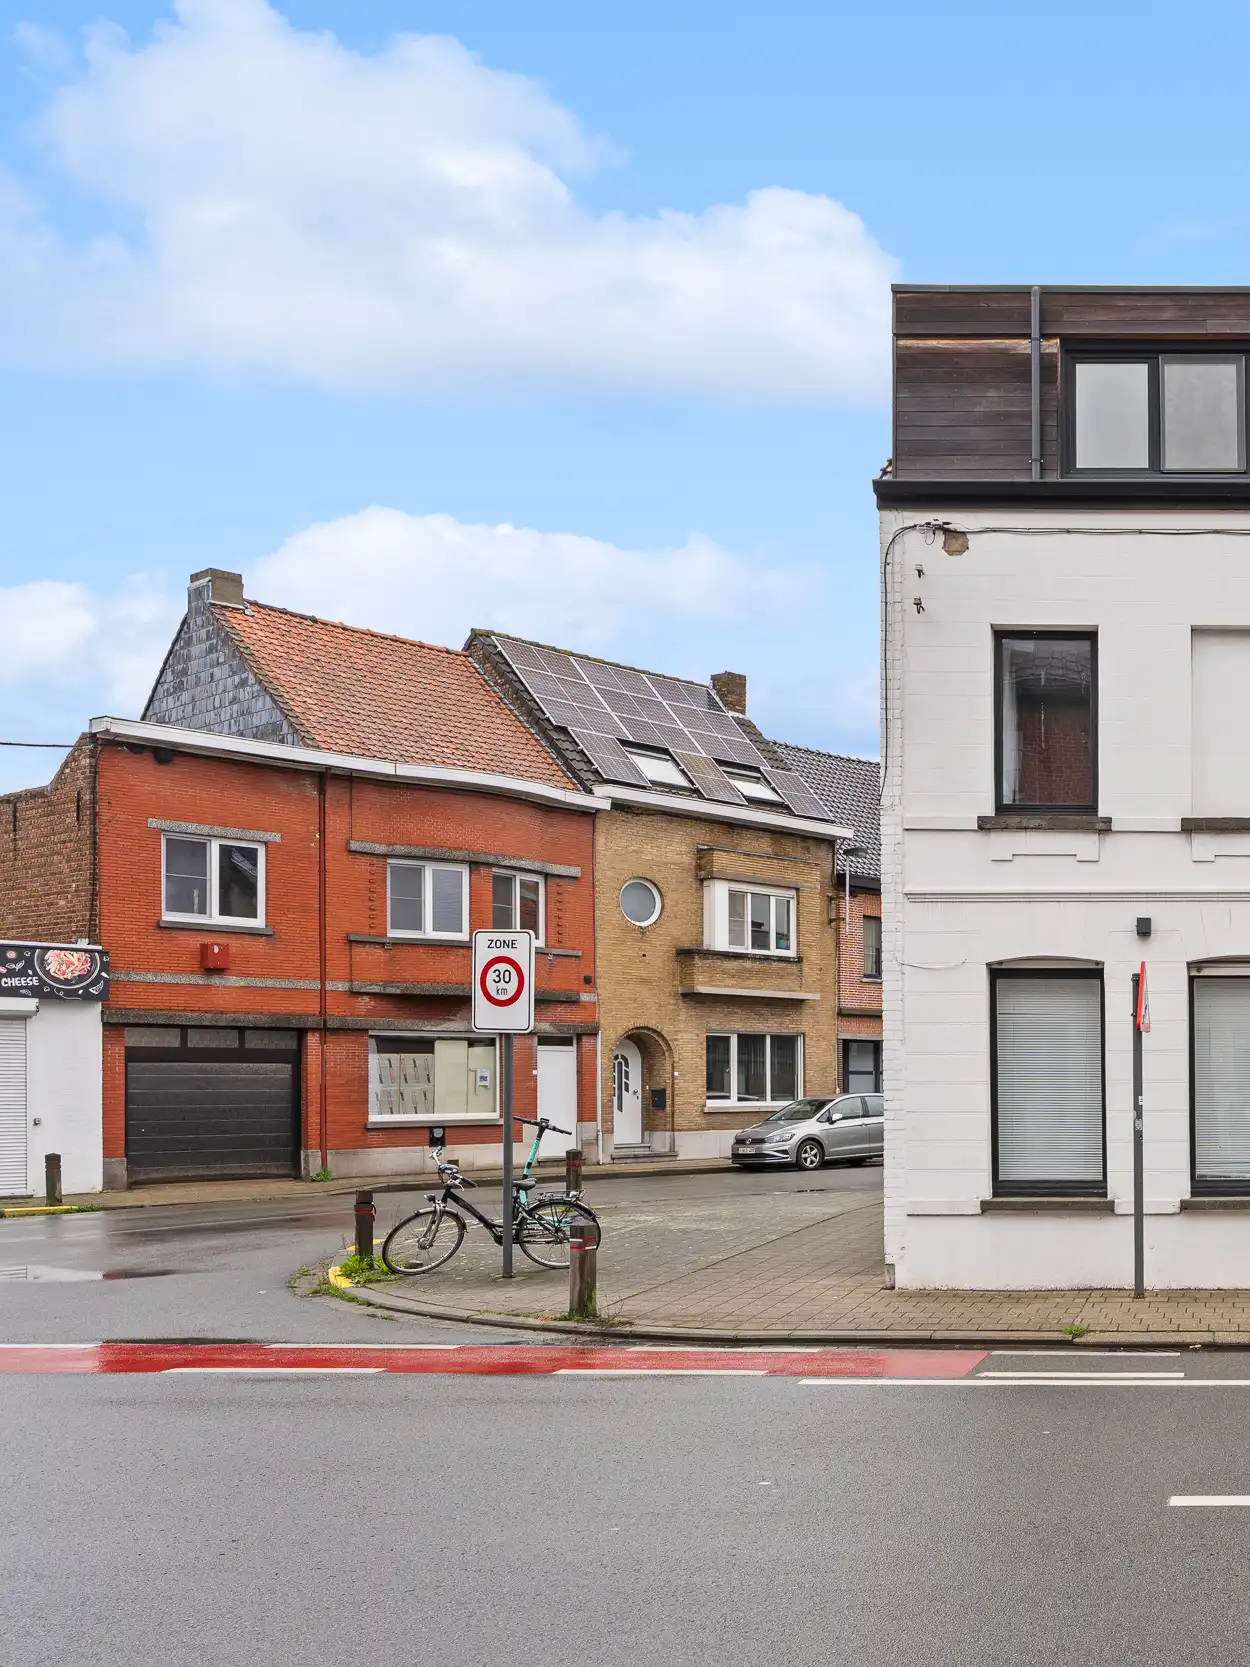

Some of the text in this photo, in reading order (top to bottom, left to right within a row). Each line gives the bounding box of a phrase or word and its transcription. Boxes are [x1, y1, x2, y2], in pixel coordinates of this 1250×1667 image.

[487, 939, 518, 949] ZONE
[492, 968, 512, 984] 30
[1, 976, 40, 988] CHEESE
[496, 985, 508, 996] km
